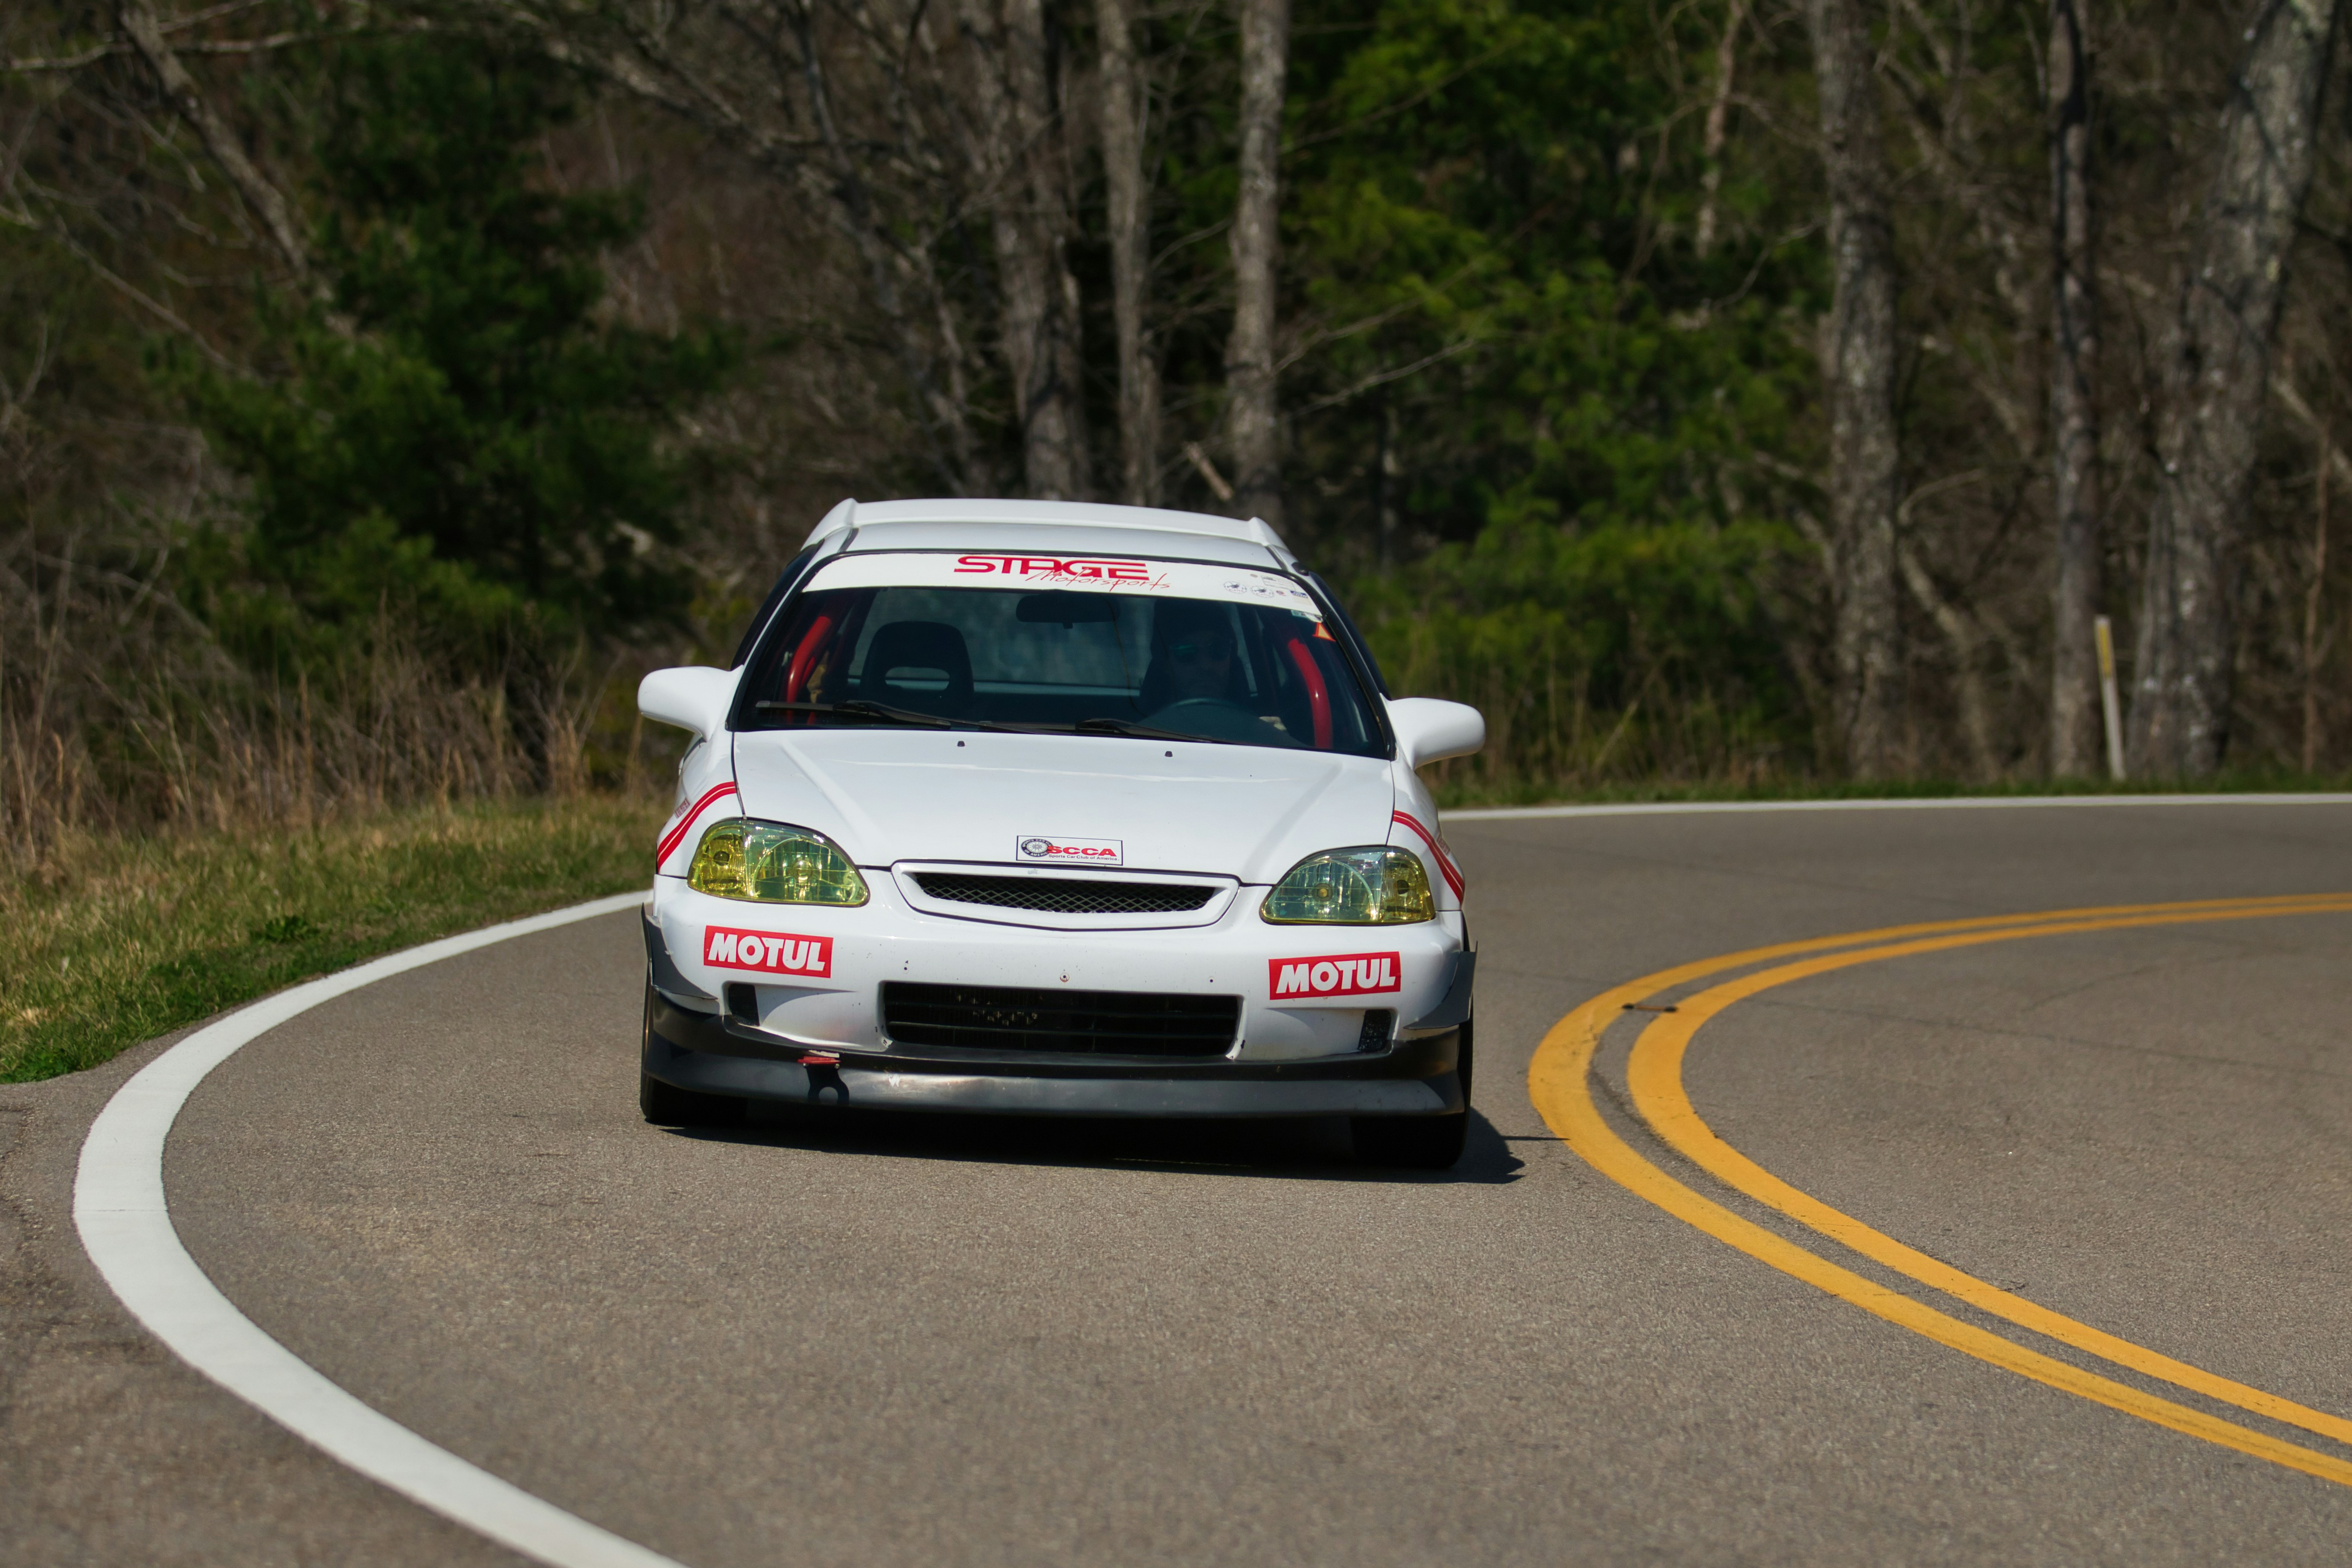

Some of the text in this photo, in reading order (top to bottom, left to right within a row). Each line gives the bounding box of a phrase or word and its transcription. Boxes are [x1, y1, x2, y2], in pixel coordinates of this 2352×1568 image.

[954, 556, 1150, 580] STAGE
[1025, 568, 1171, 592] Motorsports
[1047, 846, 1117, 857] SCCA
[708, 932, 825, 971] MOTUL
[1276, 958, 1396, 993] MOTUL
